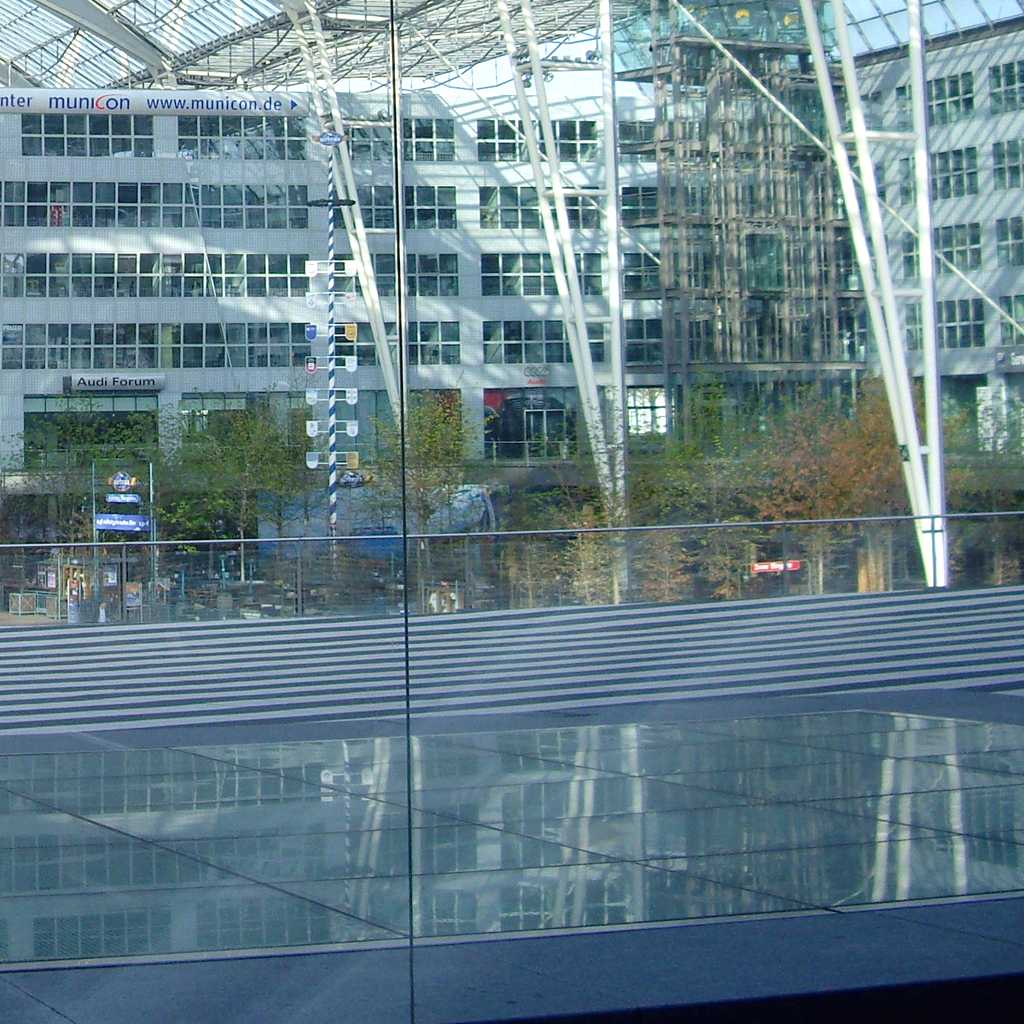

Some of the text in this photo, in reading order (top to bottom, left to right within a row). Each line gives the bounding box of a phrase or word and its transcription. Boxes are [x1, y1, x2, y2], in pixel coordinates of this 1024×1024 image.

[146, 94, 283, 112] www.municon.de
[77, 377, 156, 387] Audi Forum
